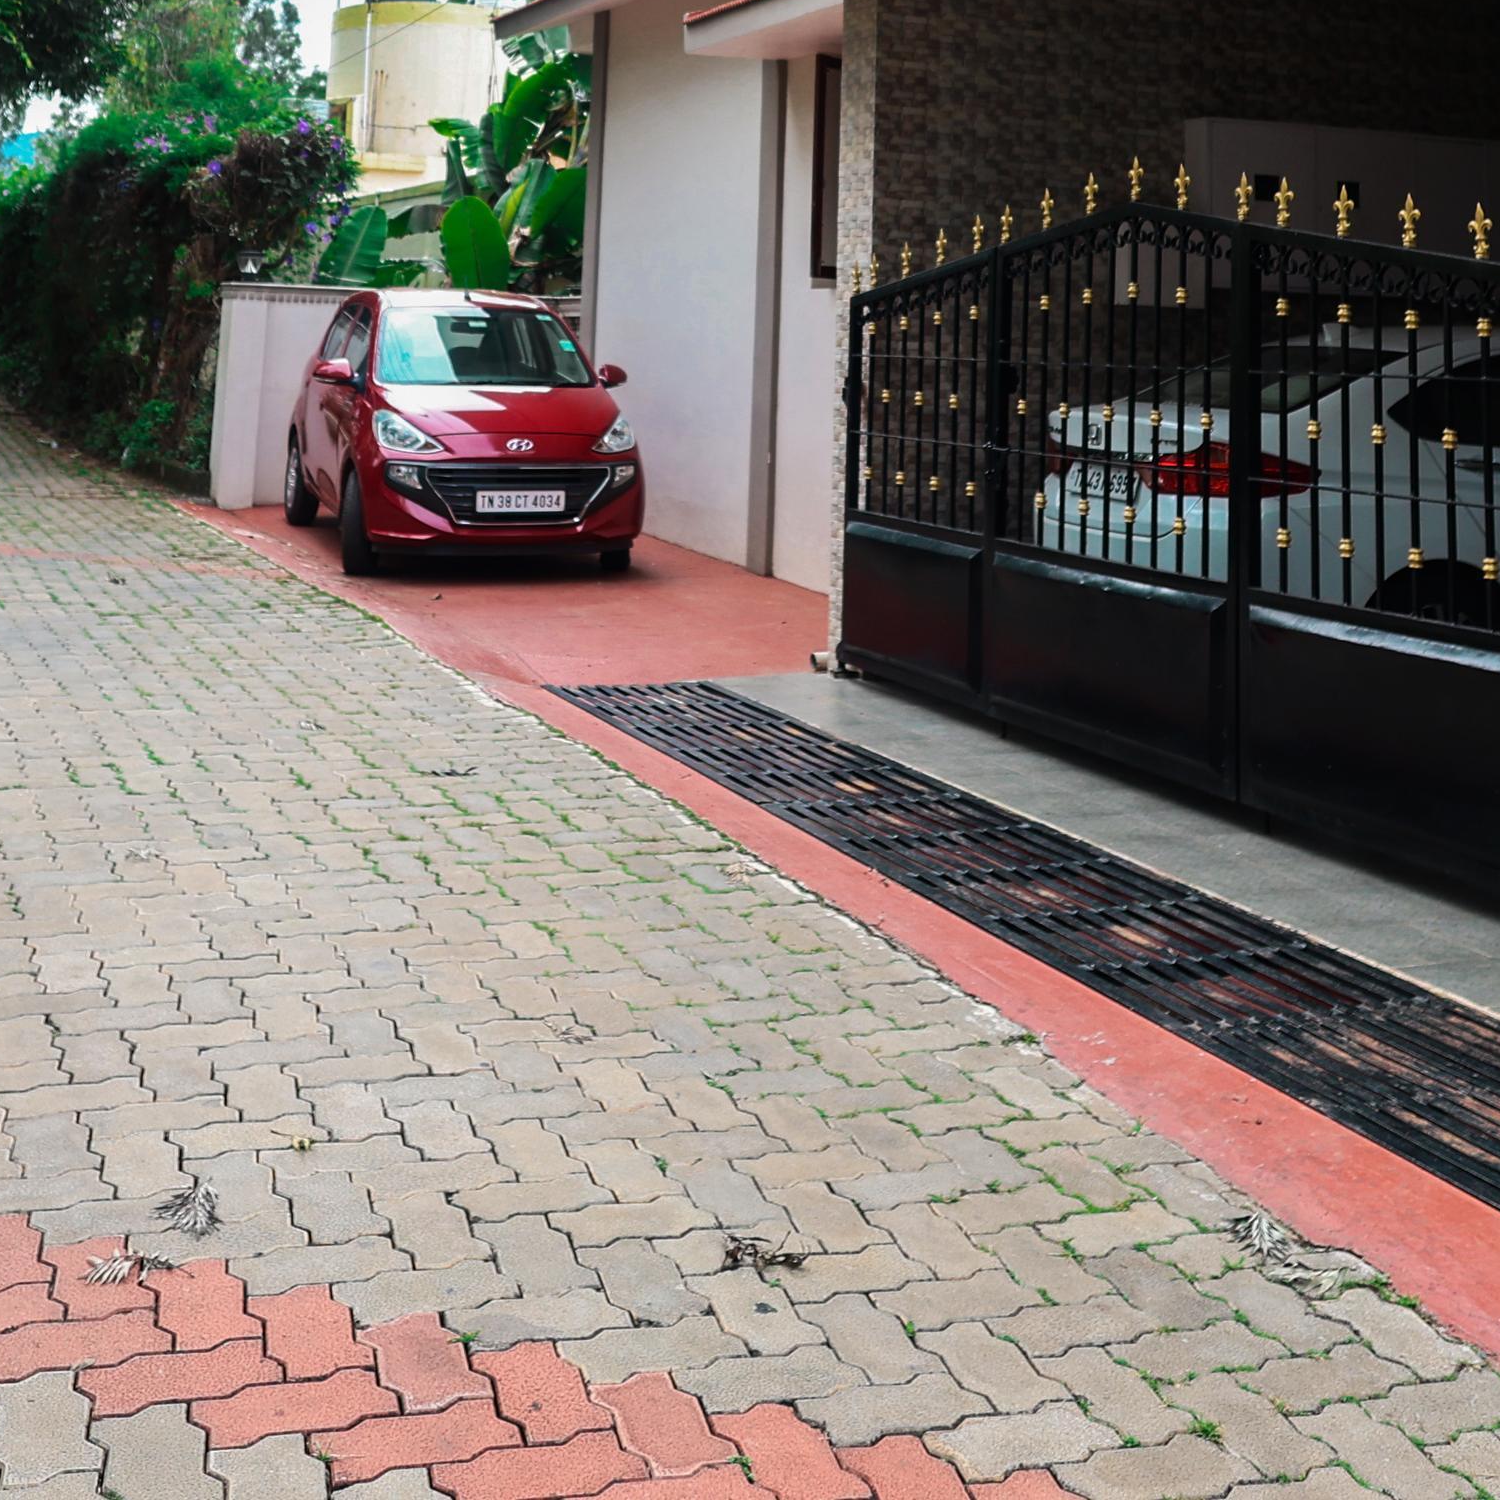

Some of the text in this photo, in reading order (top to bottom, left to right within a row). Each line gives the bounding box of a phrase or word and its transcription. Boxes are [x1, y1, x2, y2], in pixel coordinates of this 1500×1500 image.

[481, 495, 561, 509] TN 38 CT 4034
